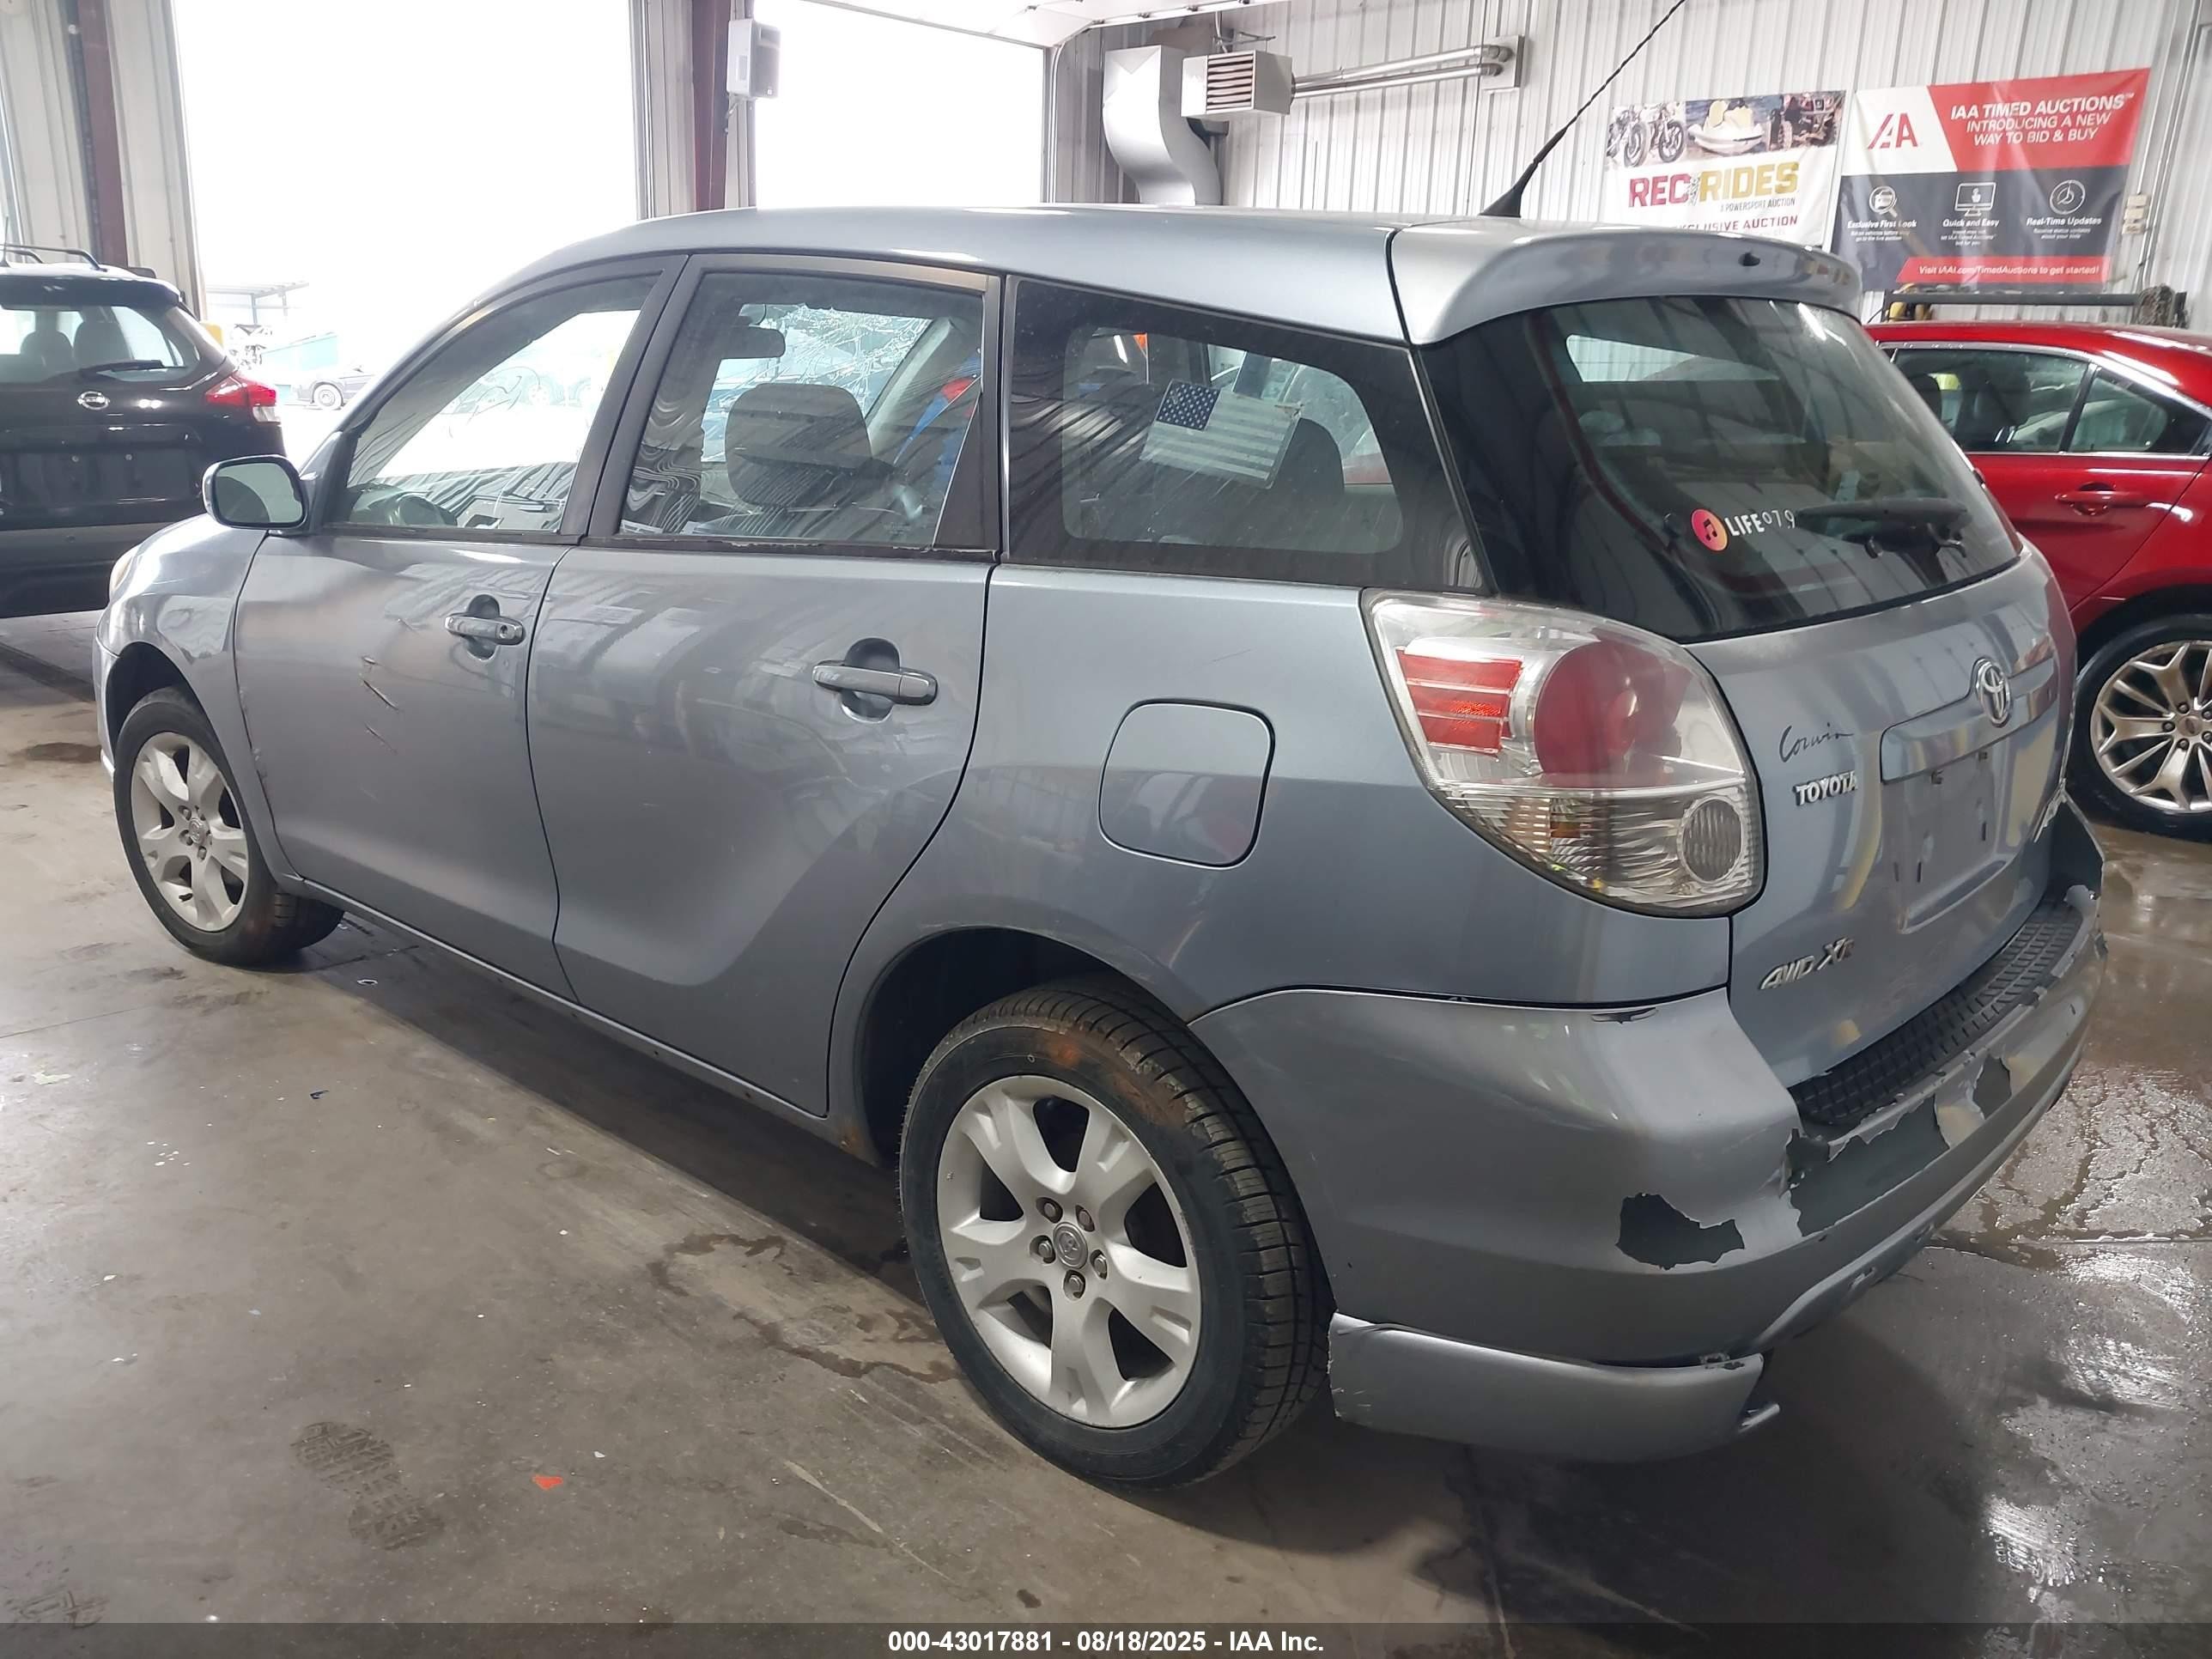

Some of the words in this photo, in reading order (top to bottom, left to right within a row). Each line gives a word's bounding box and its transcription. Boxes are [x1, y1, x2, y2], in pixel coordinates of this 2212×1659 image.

[1951, 104, 1978, 119] IAA
[1982, 100, 2031, 118] TIMED
[1966, 115, 2057, 132] INTRODUCING
[2061, 116, 2071, 127] A
[2075, 112, 2112, 125] NEW
[1974, 131, 2002, 146] WAY
[2005, 130, 2024, 143] TO
[2027, 130, 2050, 143] BID
[2052, 129, 2063, 143] &
[2067, 127, 2100, 141] BUY
[1629, 173, 1691, 207] REC
[1699, 161, 1799, 203] RIDES
[1725, 201, 1765, 212] POWERSPORT
[1767, 198, 1796, 208] AUCTION
[1743, 216, 1798, 230] AUCTION
[1880, 219, 1896, 228] First
[1942, 218, 1965, 228] Quick
[1966, 218, 1981, 227] and
[1982, 218, 1999, 228] Easy
[2026, 217, 2065, 226] Real-Time
[2067, 216, 2102, 227] Updates
[1919, 265, 1937, 275] Visit
[2050, 266, 2063, 276] get
[2065, 265, 2100, 275] started!
[1724, 514, 1765, 536] LIFE
[1792, 770, 1857, 805] TOYOTA
[1758, 955, 1814, 989] AWD
